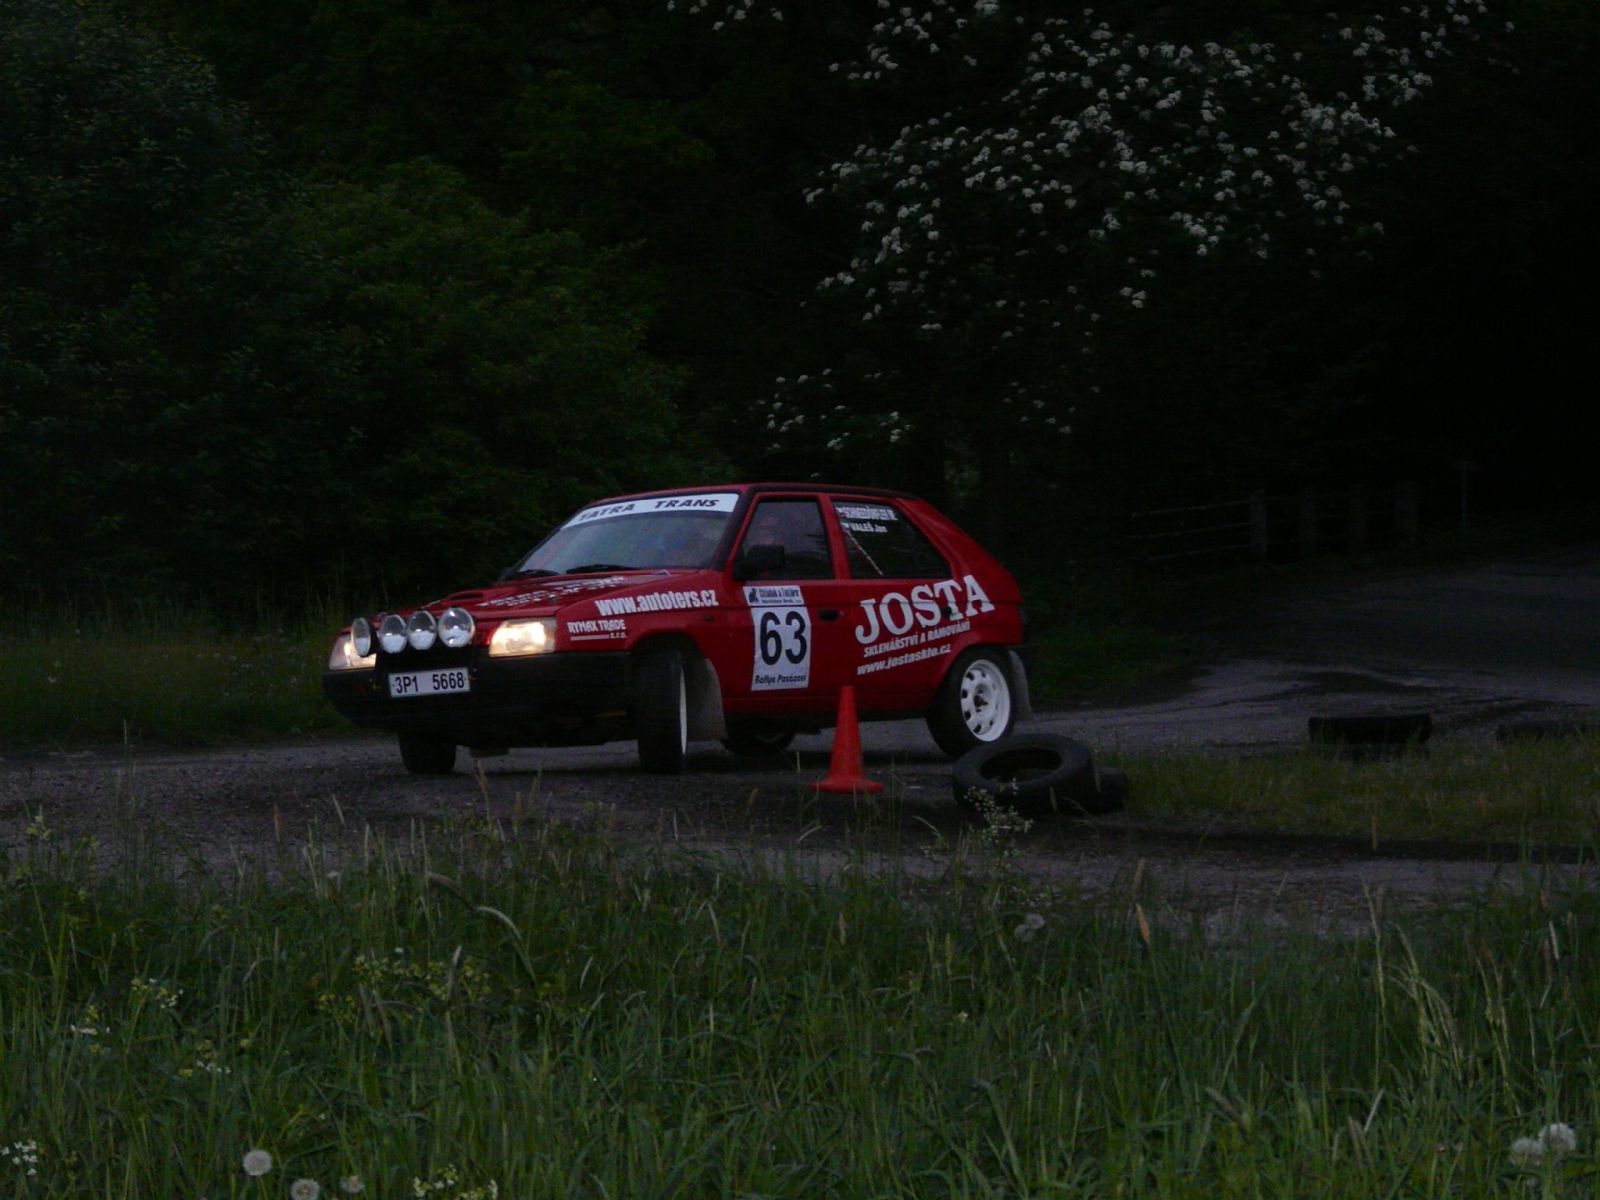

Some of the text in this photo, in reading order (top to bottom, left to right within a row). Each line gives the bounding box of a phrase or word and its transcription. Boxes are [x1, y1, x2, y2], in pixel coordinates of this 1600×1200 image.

[579, 499, 720, 521] TATRA TRANS
[594, 589, 720, 617] www.autoters.cz
[854, 574, 996, 645] JOSTA
[598, 619, 627, 631] TRADE
[760, 611, 807, 665] 63
[863, 632, 919, 658] SKLENÁŘSTVÍ
[919, 632, 926, 643] A
[857, 643, 951, 675] www.jostasklo.cz
[395, 672, 465, 694] 3P1 5668
